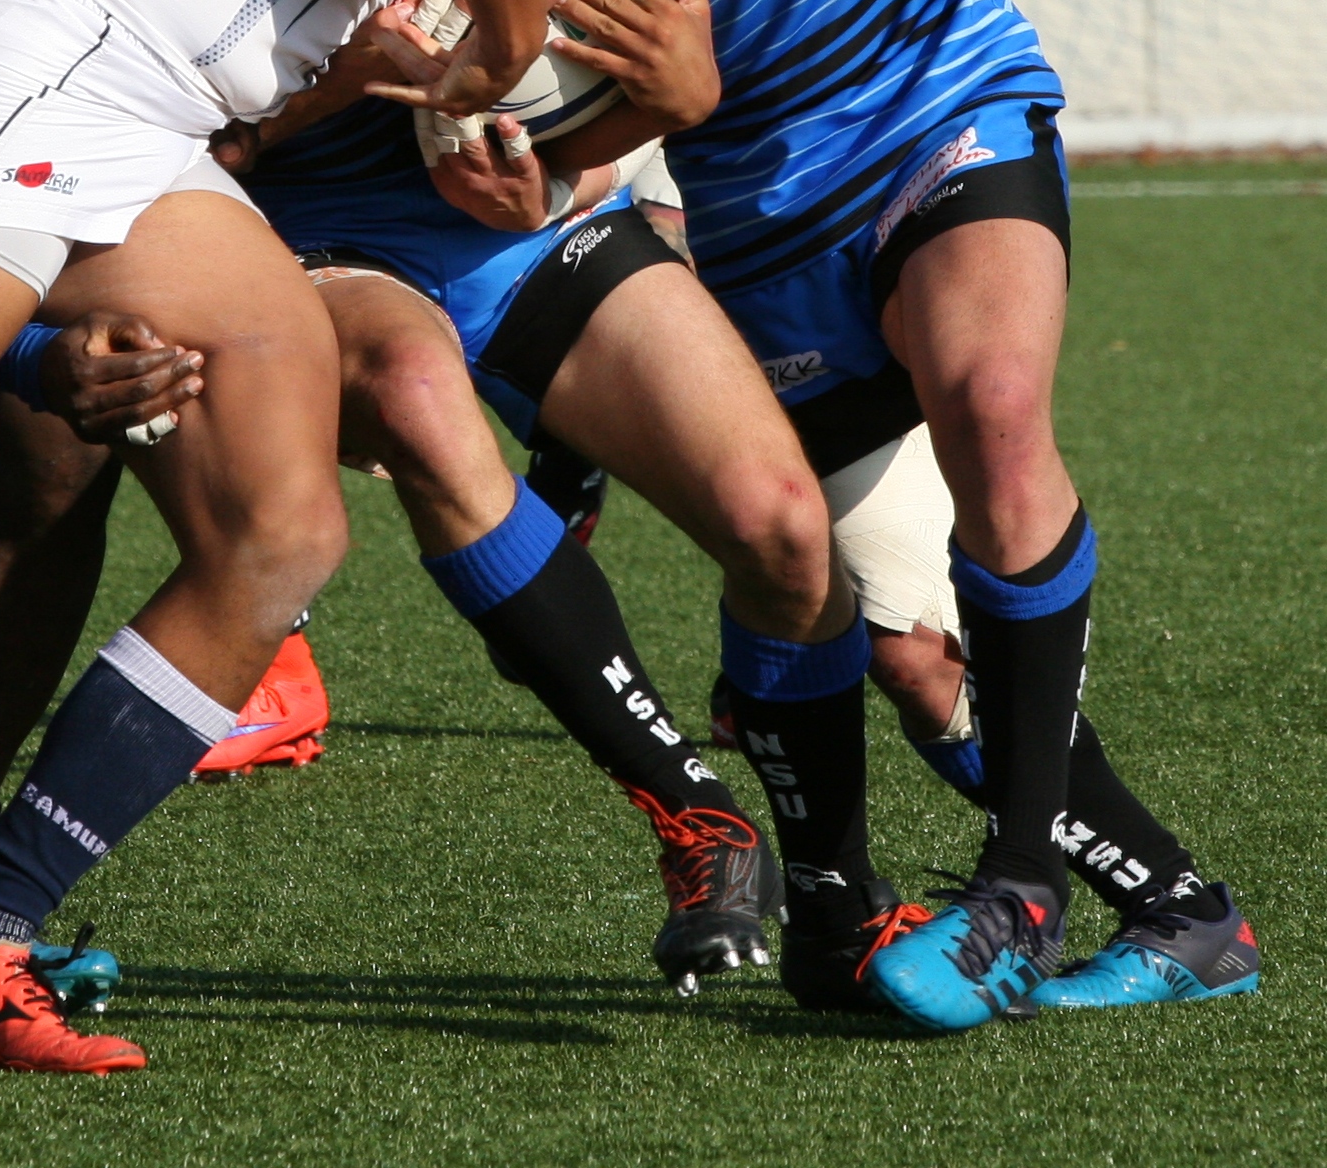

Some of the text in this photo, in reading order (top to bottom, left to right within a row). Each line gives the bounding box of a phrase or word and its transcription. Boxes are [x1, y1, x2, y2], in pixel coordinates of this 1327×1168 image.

[577, 226, 597, 248] NSU
[583, 225, 613, 254] RUGBY
[602, 655, 682, 746] NSU
[746, 730, 807, 819] NSU
